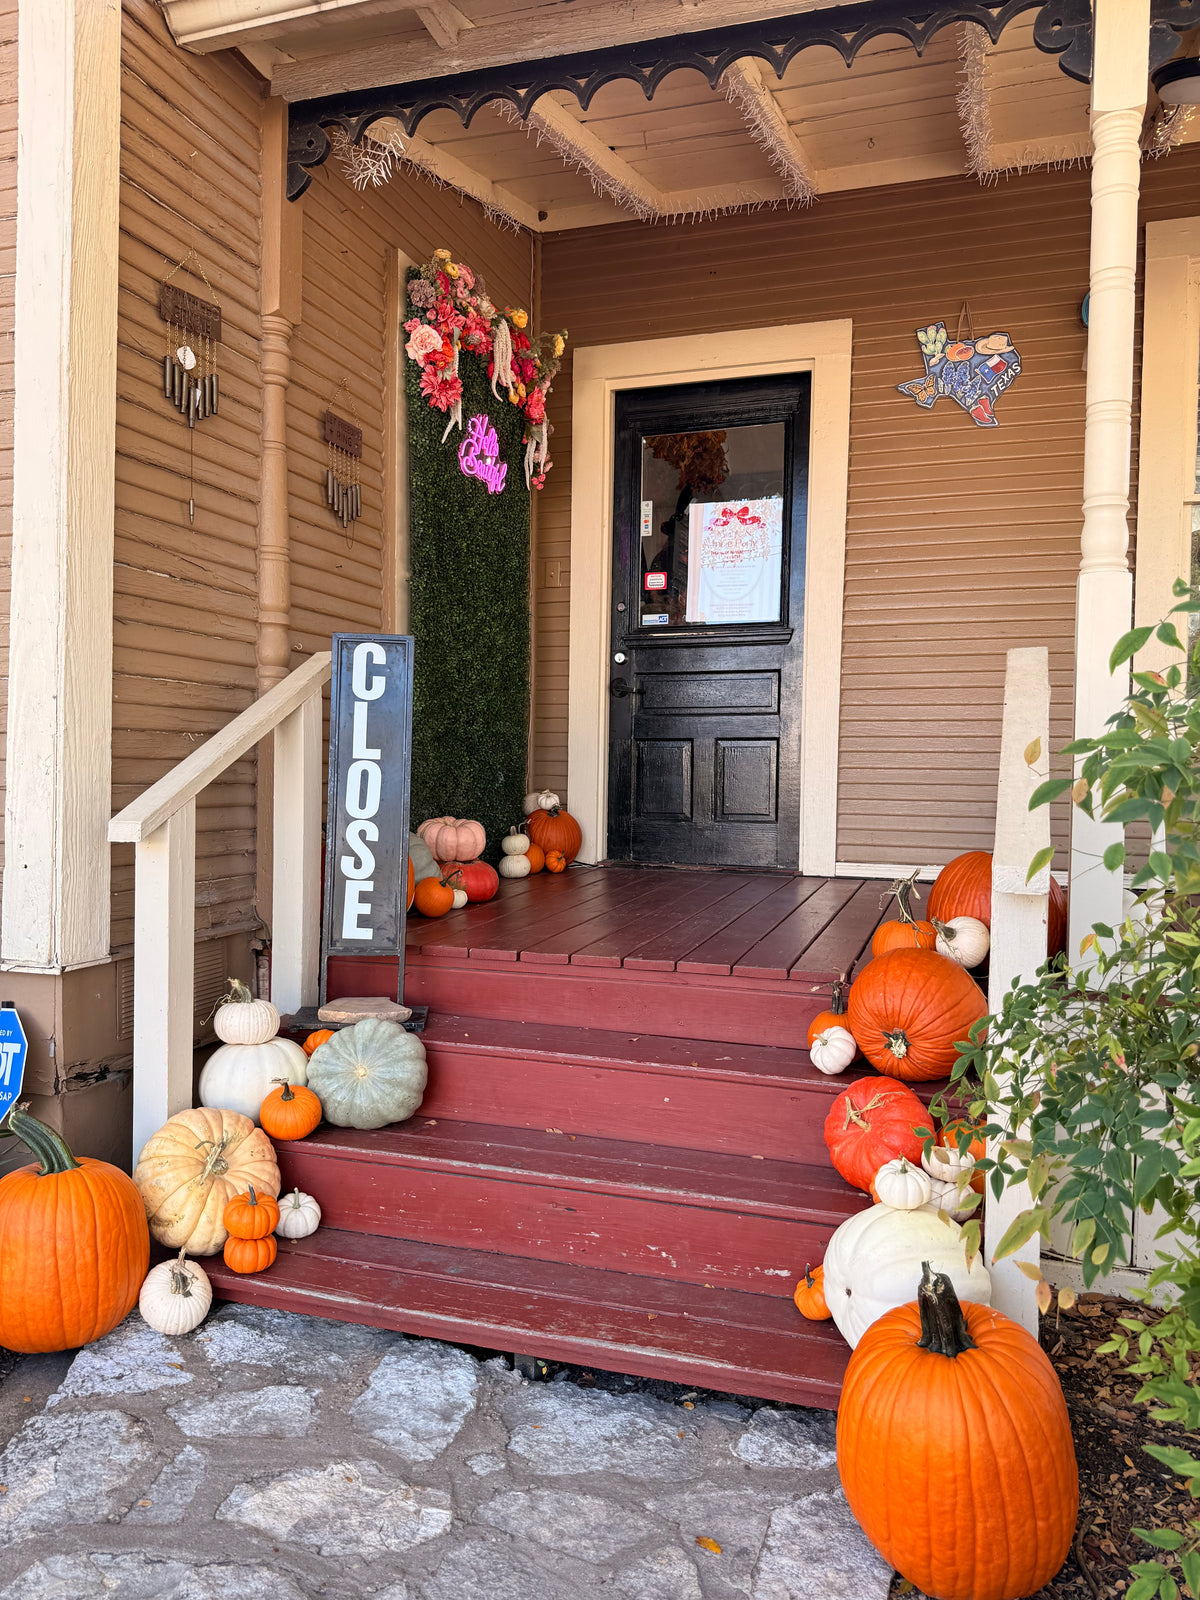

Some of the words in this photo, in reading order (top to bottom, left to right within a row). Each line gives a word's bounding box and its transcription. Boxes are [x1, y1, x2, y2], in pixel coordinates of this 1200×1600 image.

[990, 362, 1021, 397] TEXAS
[468, 413, 499, 457] Hello
[341, 642, 387, 940] CLOSE
